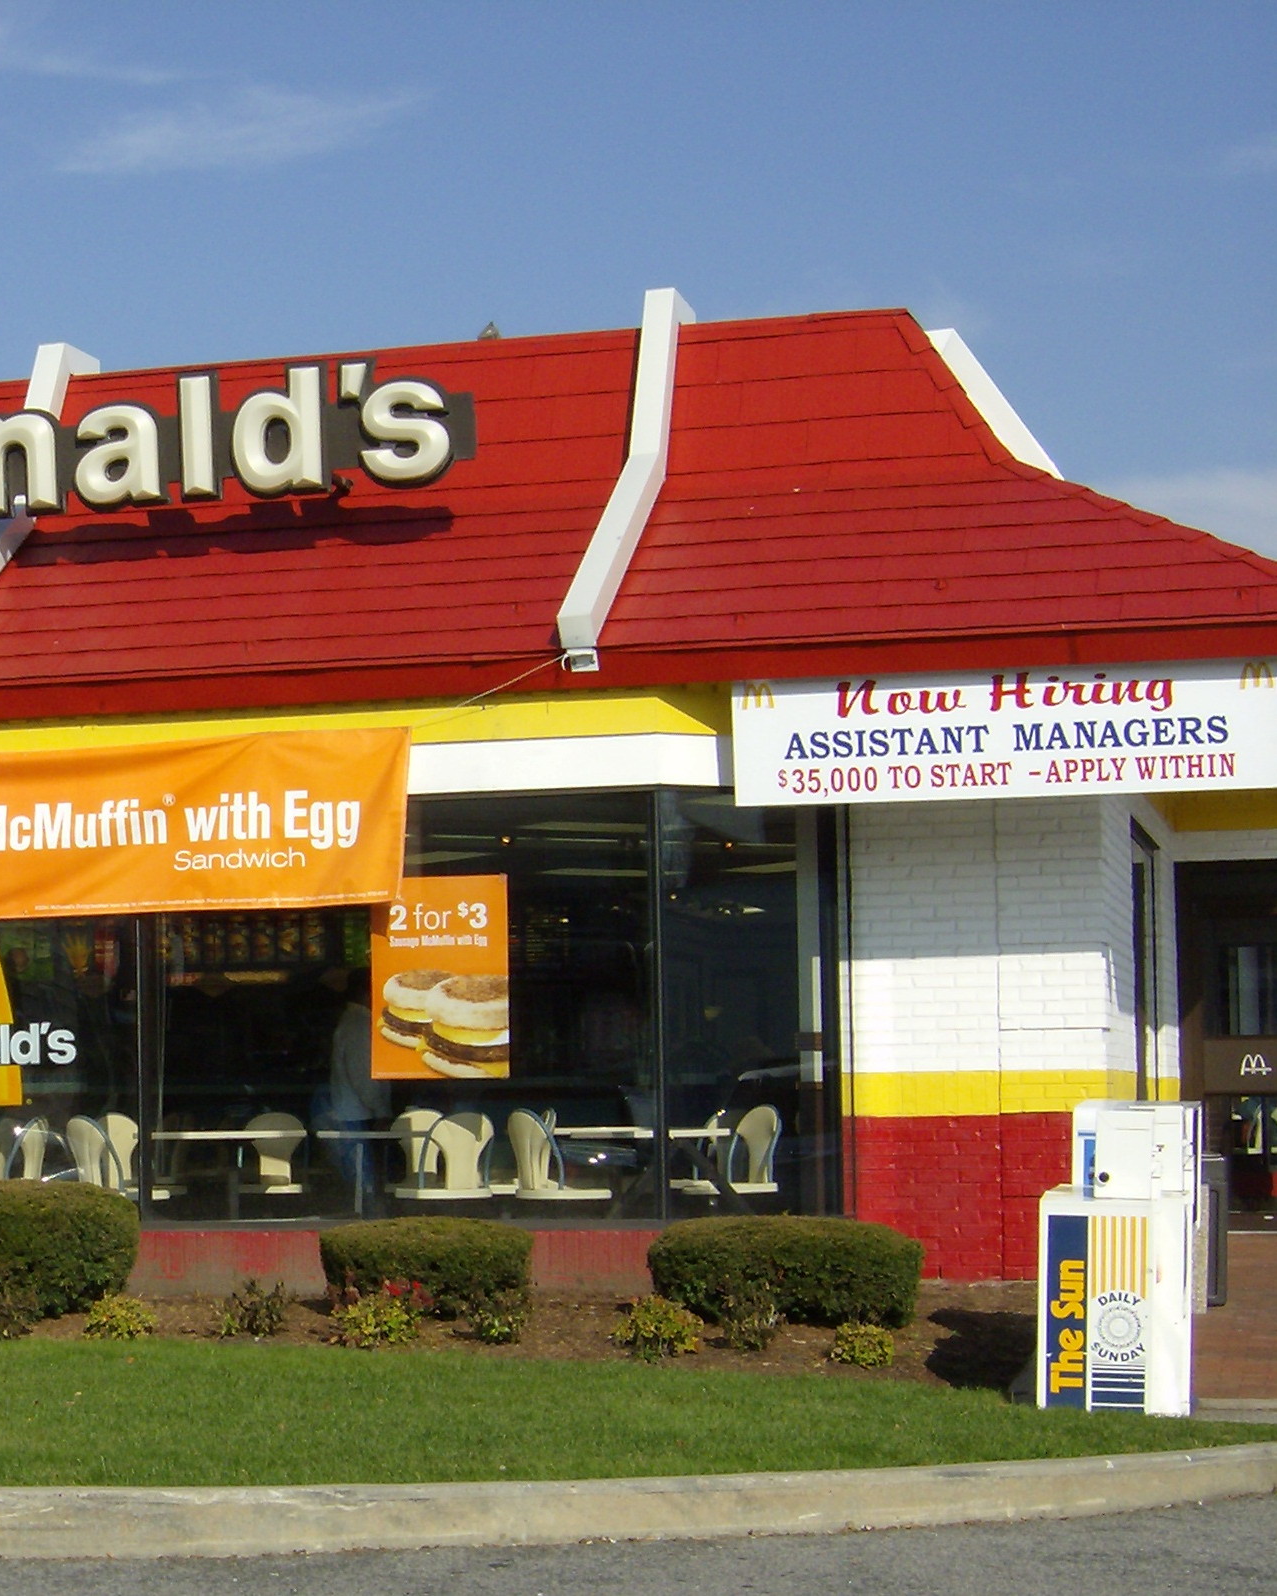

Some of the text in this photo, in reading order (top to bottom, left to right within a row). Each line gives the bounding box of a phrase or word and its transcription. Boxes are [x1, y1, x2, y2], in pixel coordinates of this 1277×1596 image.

[836, 672, 1174, 718] Now Hiring
[784, 715, 1229, 760] ASSISTANT MANAGERS
[778, 766, 878, 797] $35,000
[887, 765, 922, 789] TO
[930, 761, 1013, 788] START
[1135, 753, 1236, 781] WITHIN
[184, 791, 271, 842] with
[284, 789, 361, 849] Egg
[173, 847, 306, 871] Sandwich
[389, 901, 488, 930] 2 for $3
[1097, 1291, 1141, 1307] DAILY
[1050, 1259, 1085, 1394] The Sun
[1090, 1342, 1145, 1362] SUNDAY
